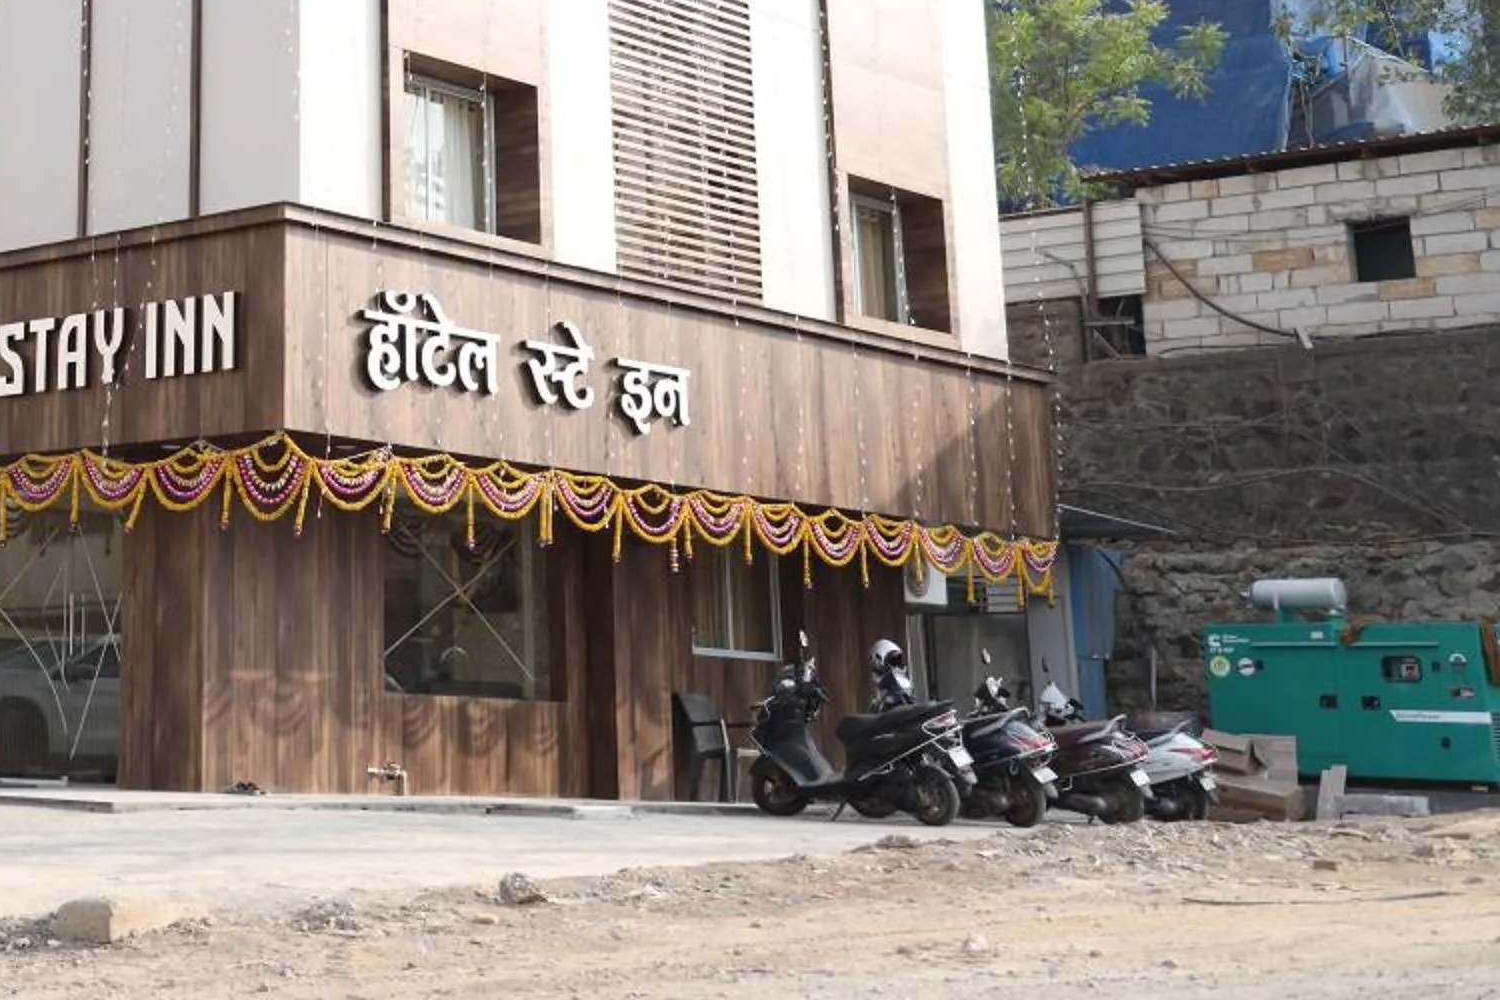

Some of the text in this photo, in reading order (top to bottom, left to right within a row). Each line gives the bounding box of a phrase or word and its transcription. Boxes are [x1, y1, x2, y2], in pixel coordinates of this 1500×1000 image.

[144, 290, 236, 379] INN
[525, 321, 595, 410] स्टे
[616, 357, 692, 434] इन
